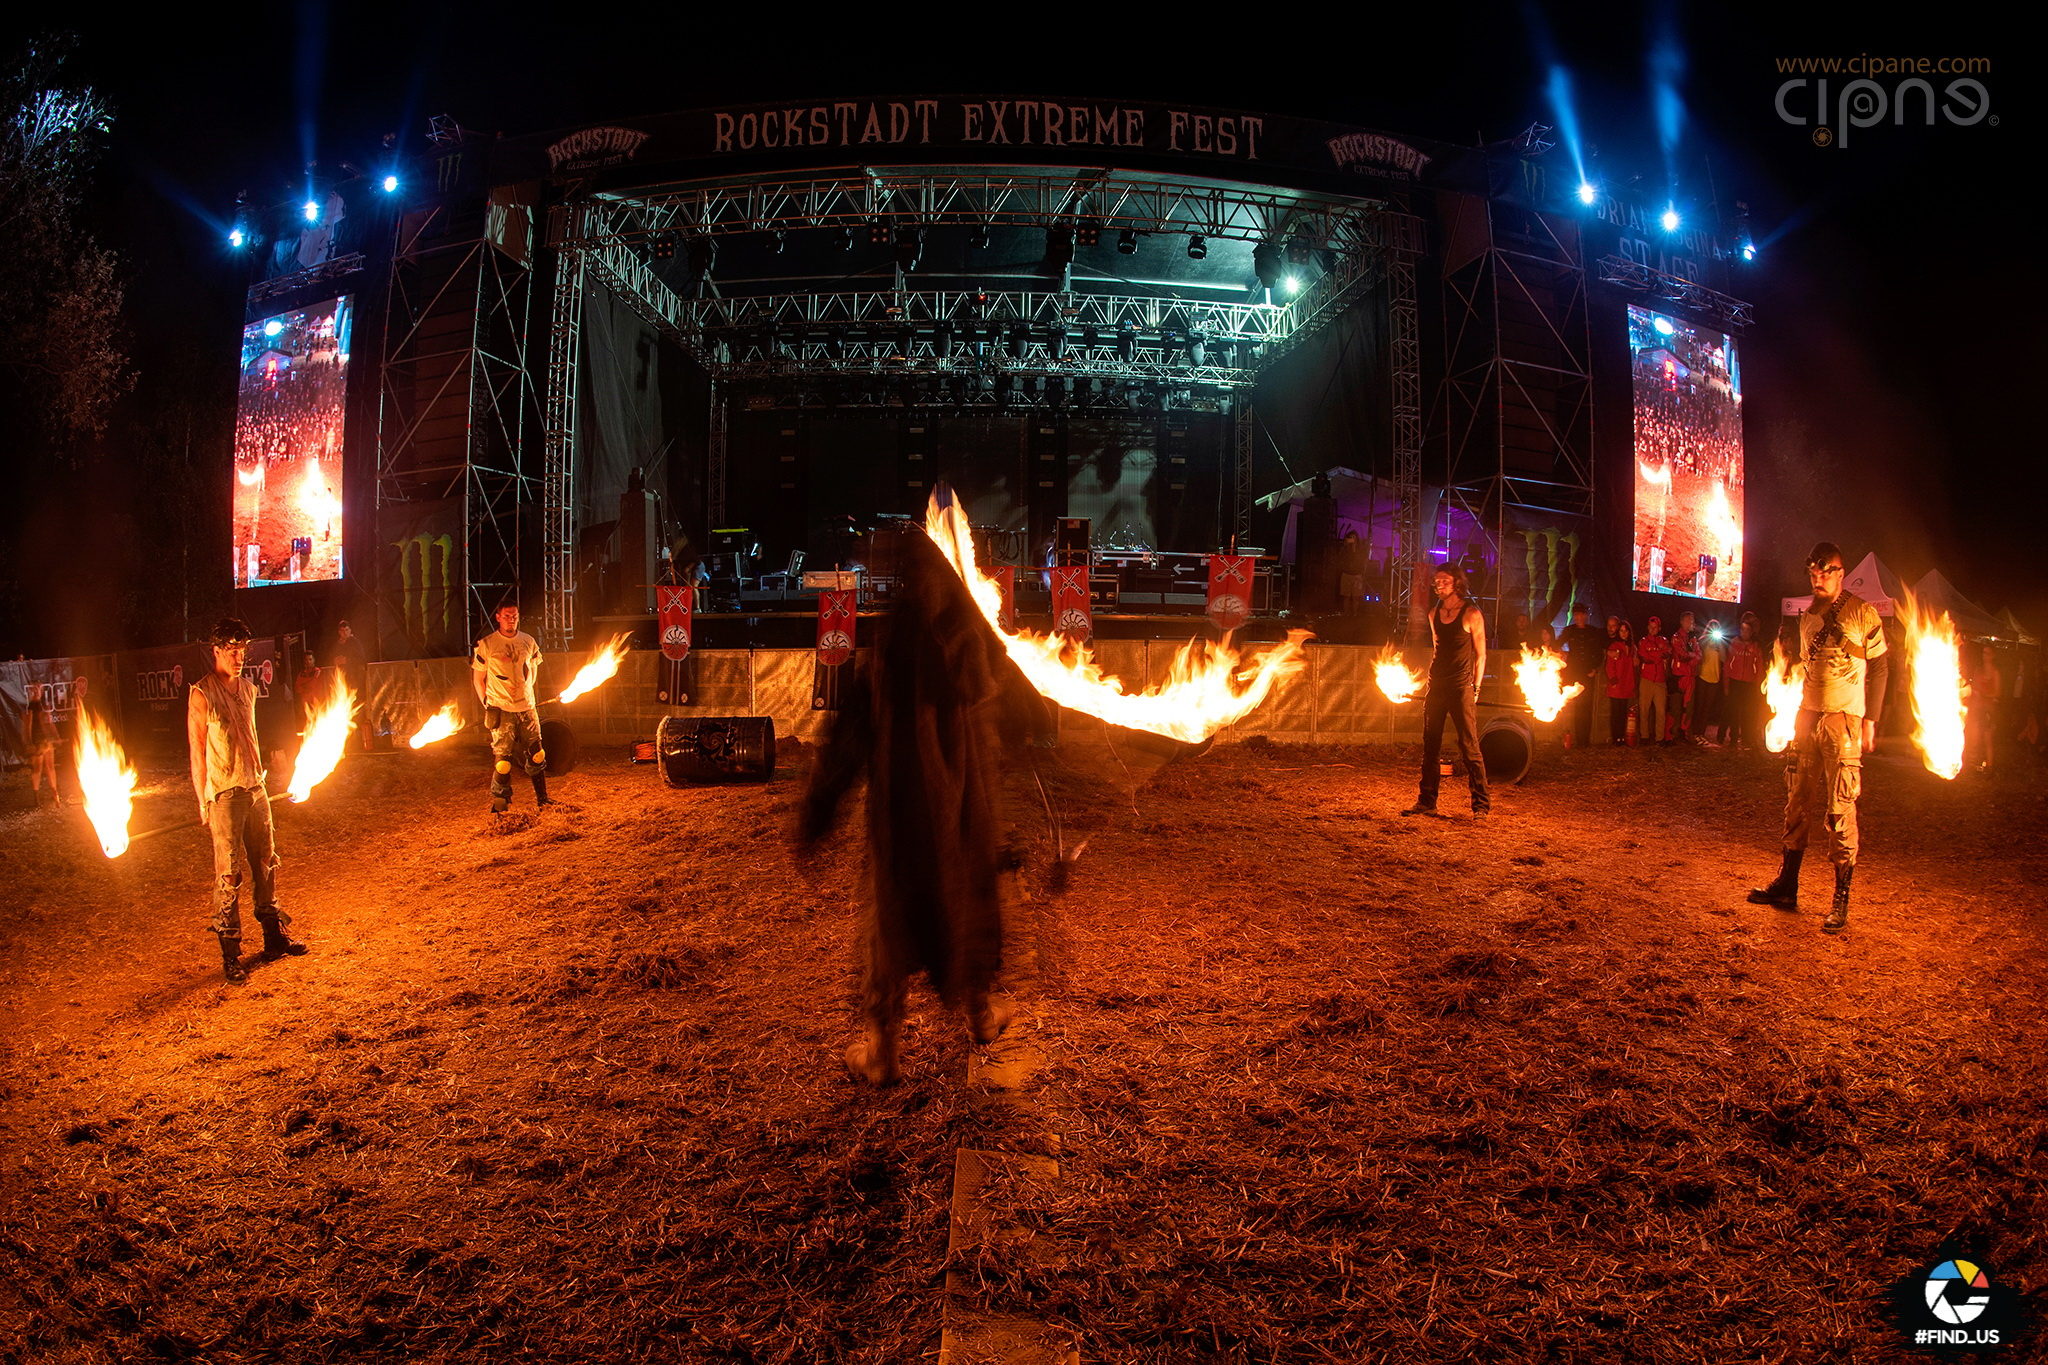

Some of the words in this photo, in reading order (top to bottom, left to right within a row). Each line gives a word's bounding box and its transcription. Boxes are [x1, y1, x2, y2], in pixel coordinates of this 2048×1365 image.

[545, 126, 652, 173] ROCKSTADT
[712, 99, 939, 153] ROCKSTADT
[961, 100, 1144, 147] EXTREME
[1167, 109, 1263, 159] FEST
[1325, 134, 1433, 180] ROCKSTADT
[136, 670, 179, 701] ROCK
